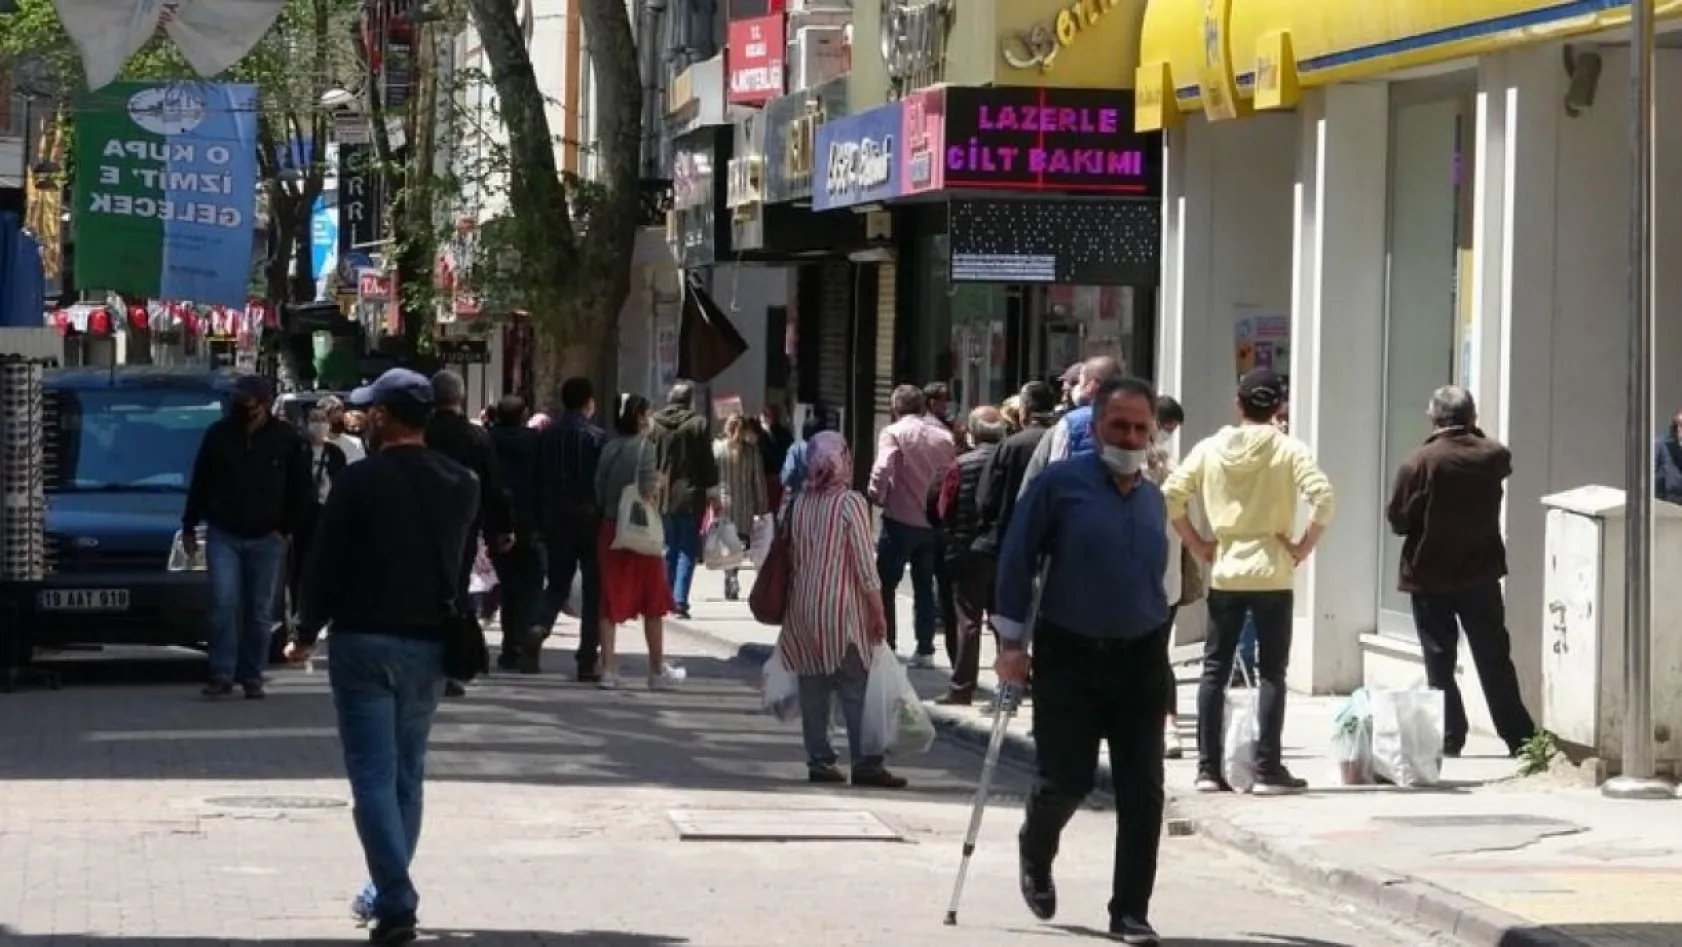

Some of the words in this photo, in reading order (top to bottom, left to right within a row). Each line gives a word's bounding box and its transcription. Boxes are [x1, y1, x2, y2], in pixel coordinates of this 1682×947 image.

[978, 105, 1117, 133] LAZERLE
[948, 136, 1018, 171] CİLT
[1028, 147, 1142, 175] BAKIMI
